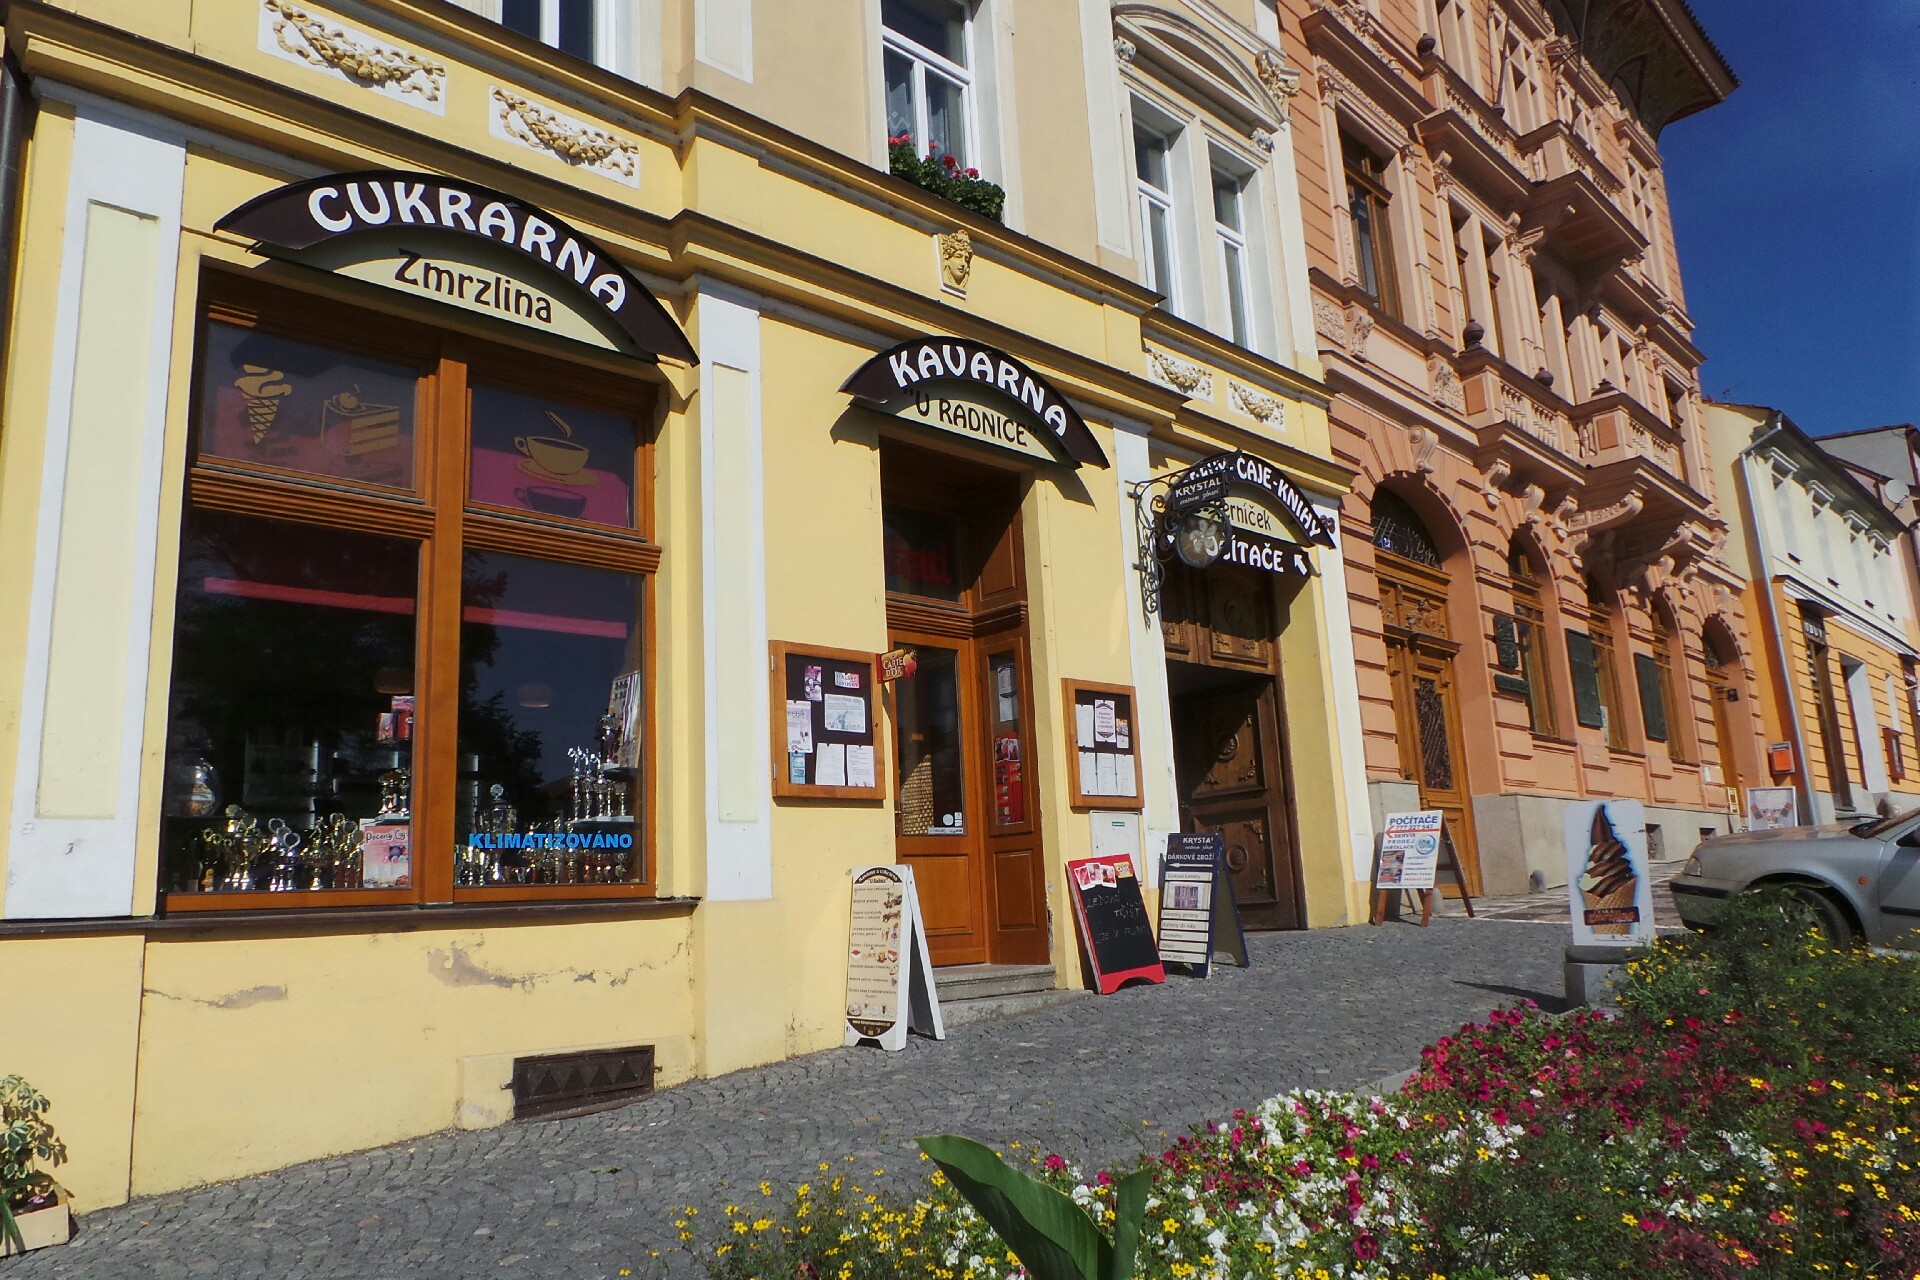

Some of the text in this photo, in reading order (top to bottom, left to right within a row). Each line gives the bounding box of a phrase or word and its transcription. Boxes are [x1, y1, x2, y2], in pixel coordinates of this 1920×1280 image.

[394, 248, 552, 324] Zmrzlina
[1175, 477, 1222, 498] KRYSTAL
[1221, 502, 1271, 531] erníček
[1198, 534, 1284, 573] OÍTAČE
[884, 657, 903, 670] CARTE
[1389, 815, 1438, 825] POČÍTAČE
[469, 830, 633, 849] KLIMATIZOVÁNO
